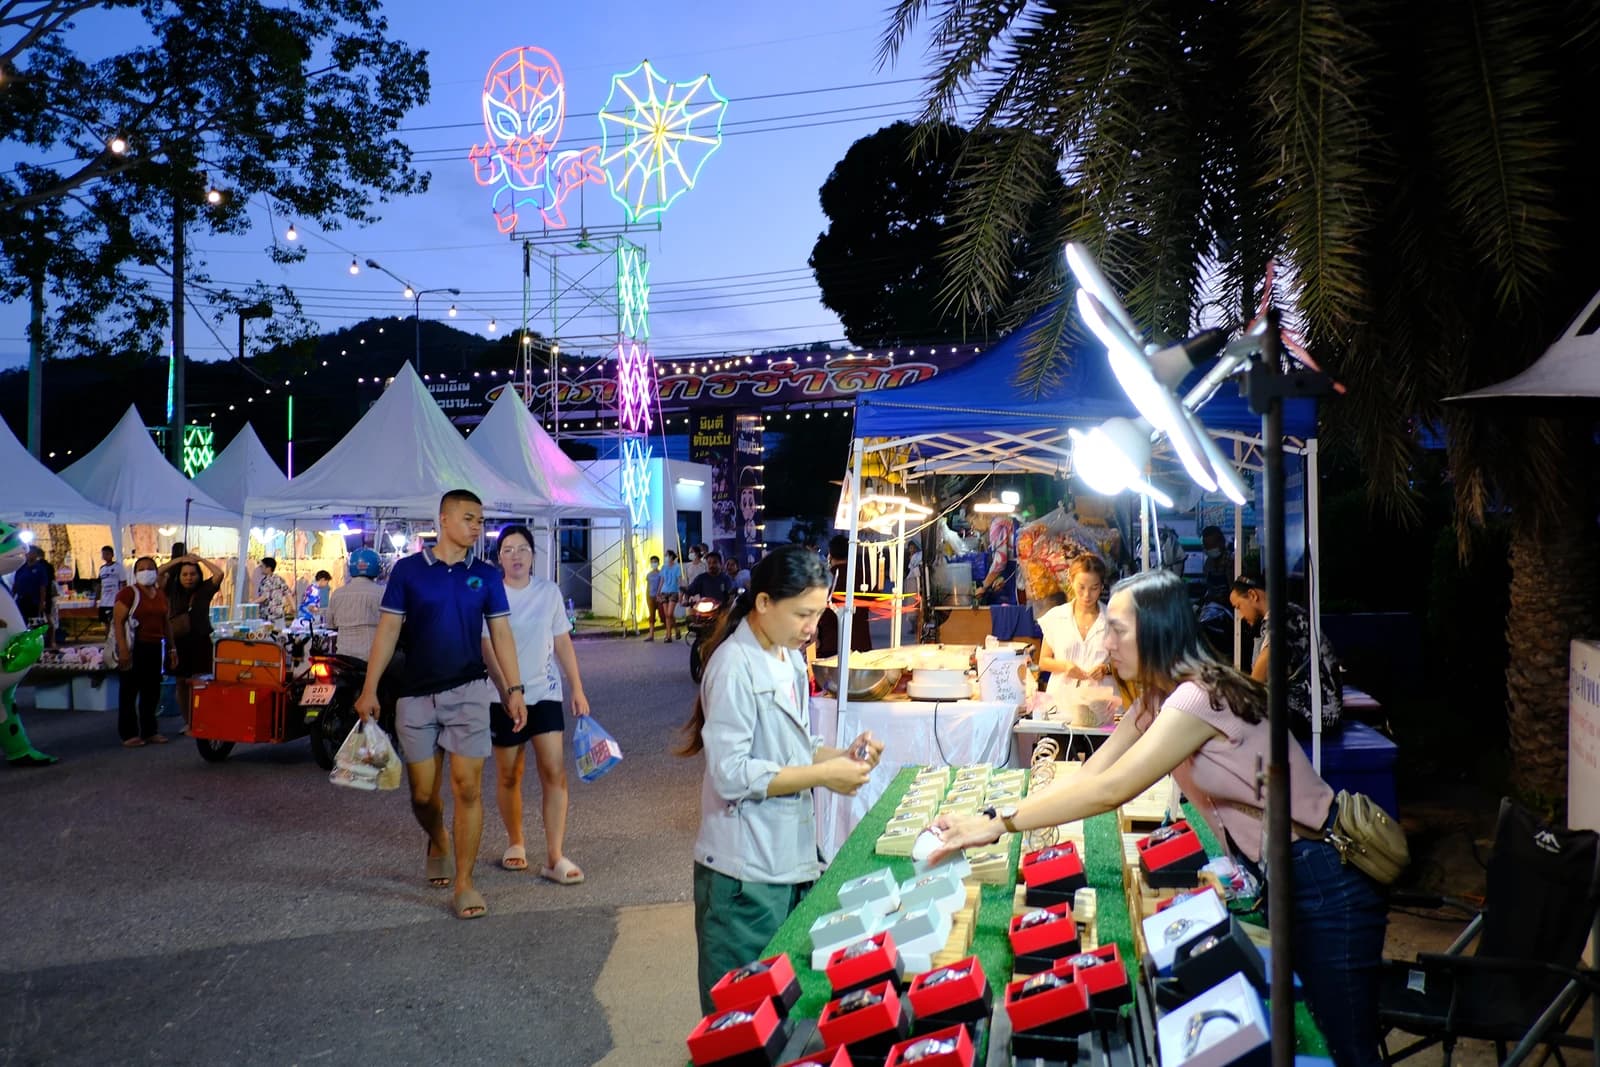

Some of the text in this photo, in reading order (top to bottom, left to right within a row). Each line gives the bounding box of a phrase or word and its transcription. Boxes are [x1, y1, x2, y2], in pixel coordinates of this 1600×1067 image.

[699, 414, 724, 431] ยินดี
[693, 431, 731, 447] ต้อนรับ
